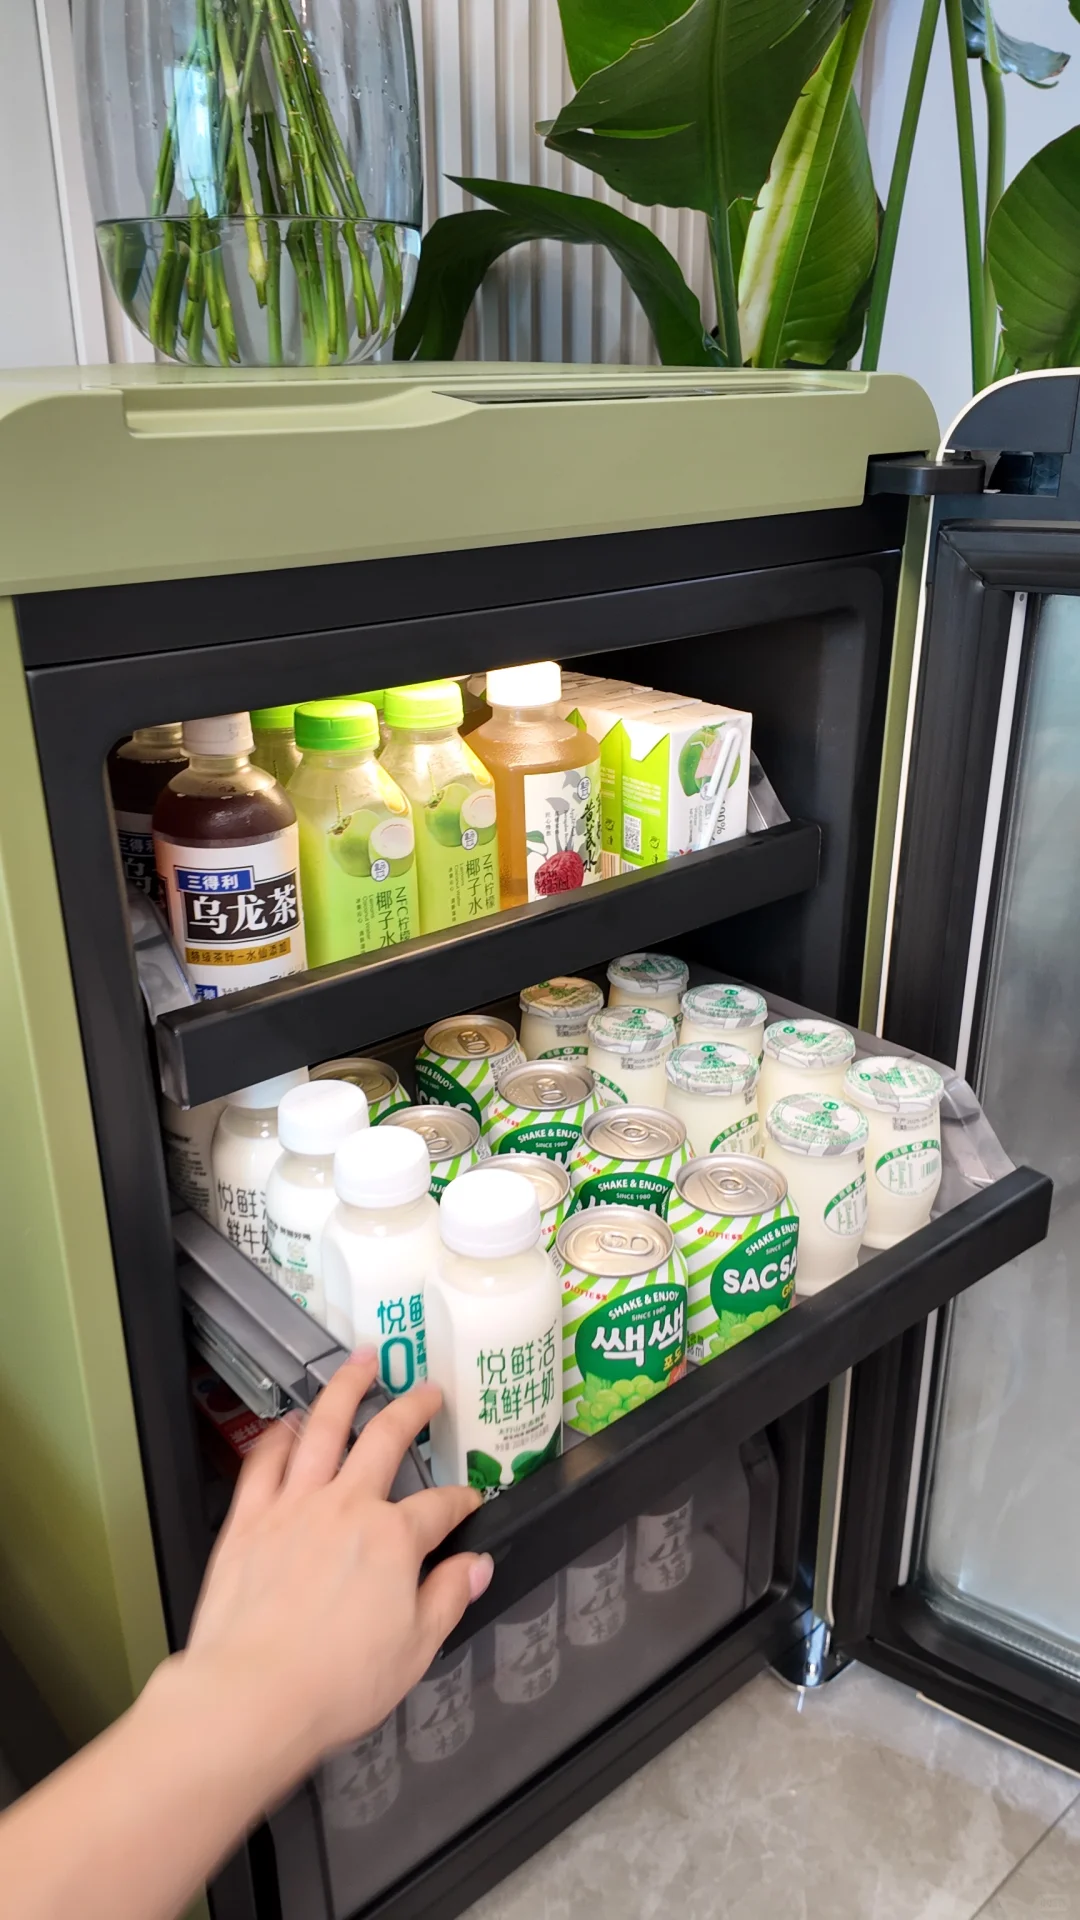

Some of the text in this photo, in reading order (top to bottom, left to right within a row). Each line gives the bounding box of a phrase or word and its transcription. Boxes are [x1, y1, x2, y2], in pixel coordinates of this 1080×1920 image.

[187, 873, 239, 890] 三得利
[466, 858, 484, 916] 椰子水
[189, 884, 297, 935] 乌龙茶
[376, 889, 398, 948] 椰子水
[432, 1071, 455, 1091] ENJOY
[517, 1129, 546, 1144] SHAKE
[547, 1128, 555, 1137] &
[598, 1179, 669, 1195] SHAKE & ENJOY
[745, 1232, 774, 1256] SHAKE
[774, 1228, 782, 1239] &
[608, 1291, 680, 1320] SHAKE & ENJOY
[631, 1309, 651, 1322] SINCE
[591, 1301, 684, 1367] 쌕쌕
[381, 1337, 415, 1394] 0
[476, 1319, 557, 1385] 悦鲜活
